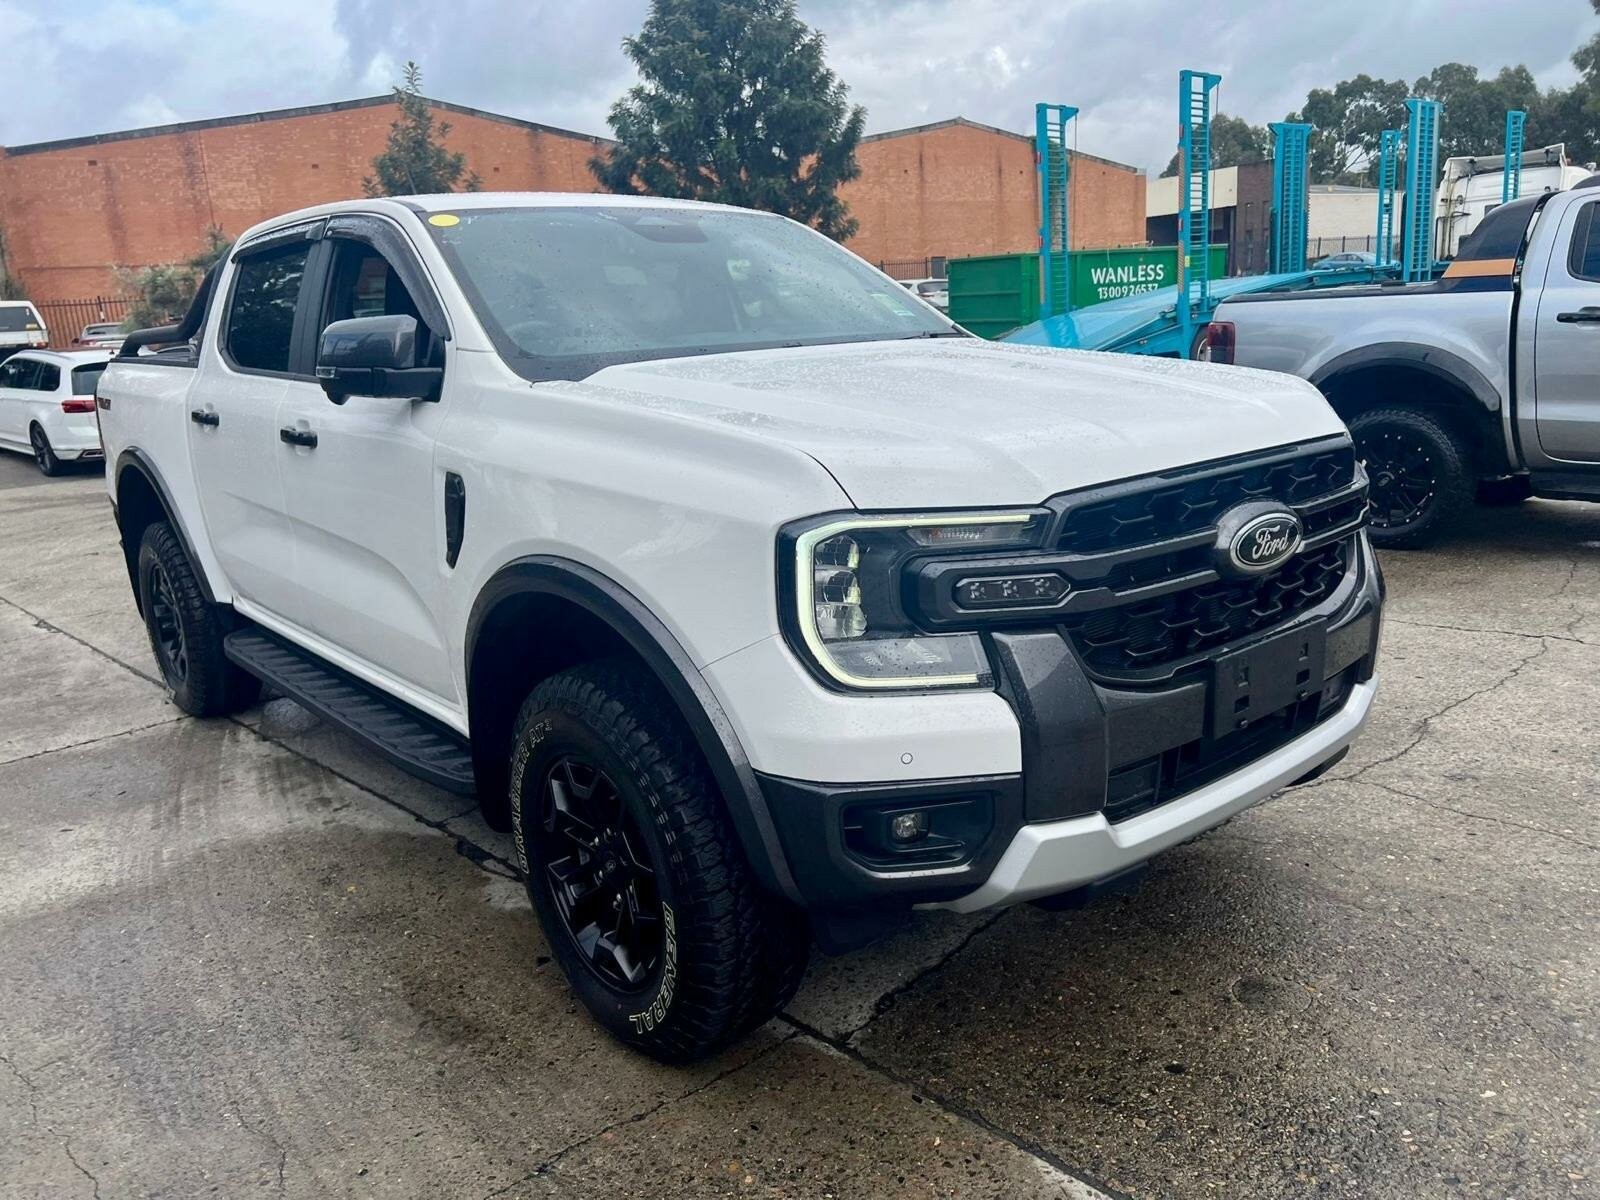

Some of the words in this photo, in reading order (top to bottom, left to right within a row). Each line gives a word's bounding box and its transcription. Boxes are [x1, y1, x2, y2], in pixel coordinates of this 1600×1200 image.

[1091, 264, 1164, 284] WANLESS
[1253, 525, 1289, 559] Ford
[629, 901, 677, 1034] GENERAL
